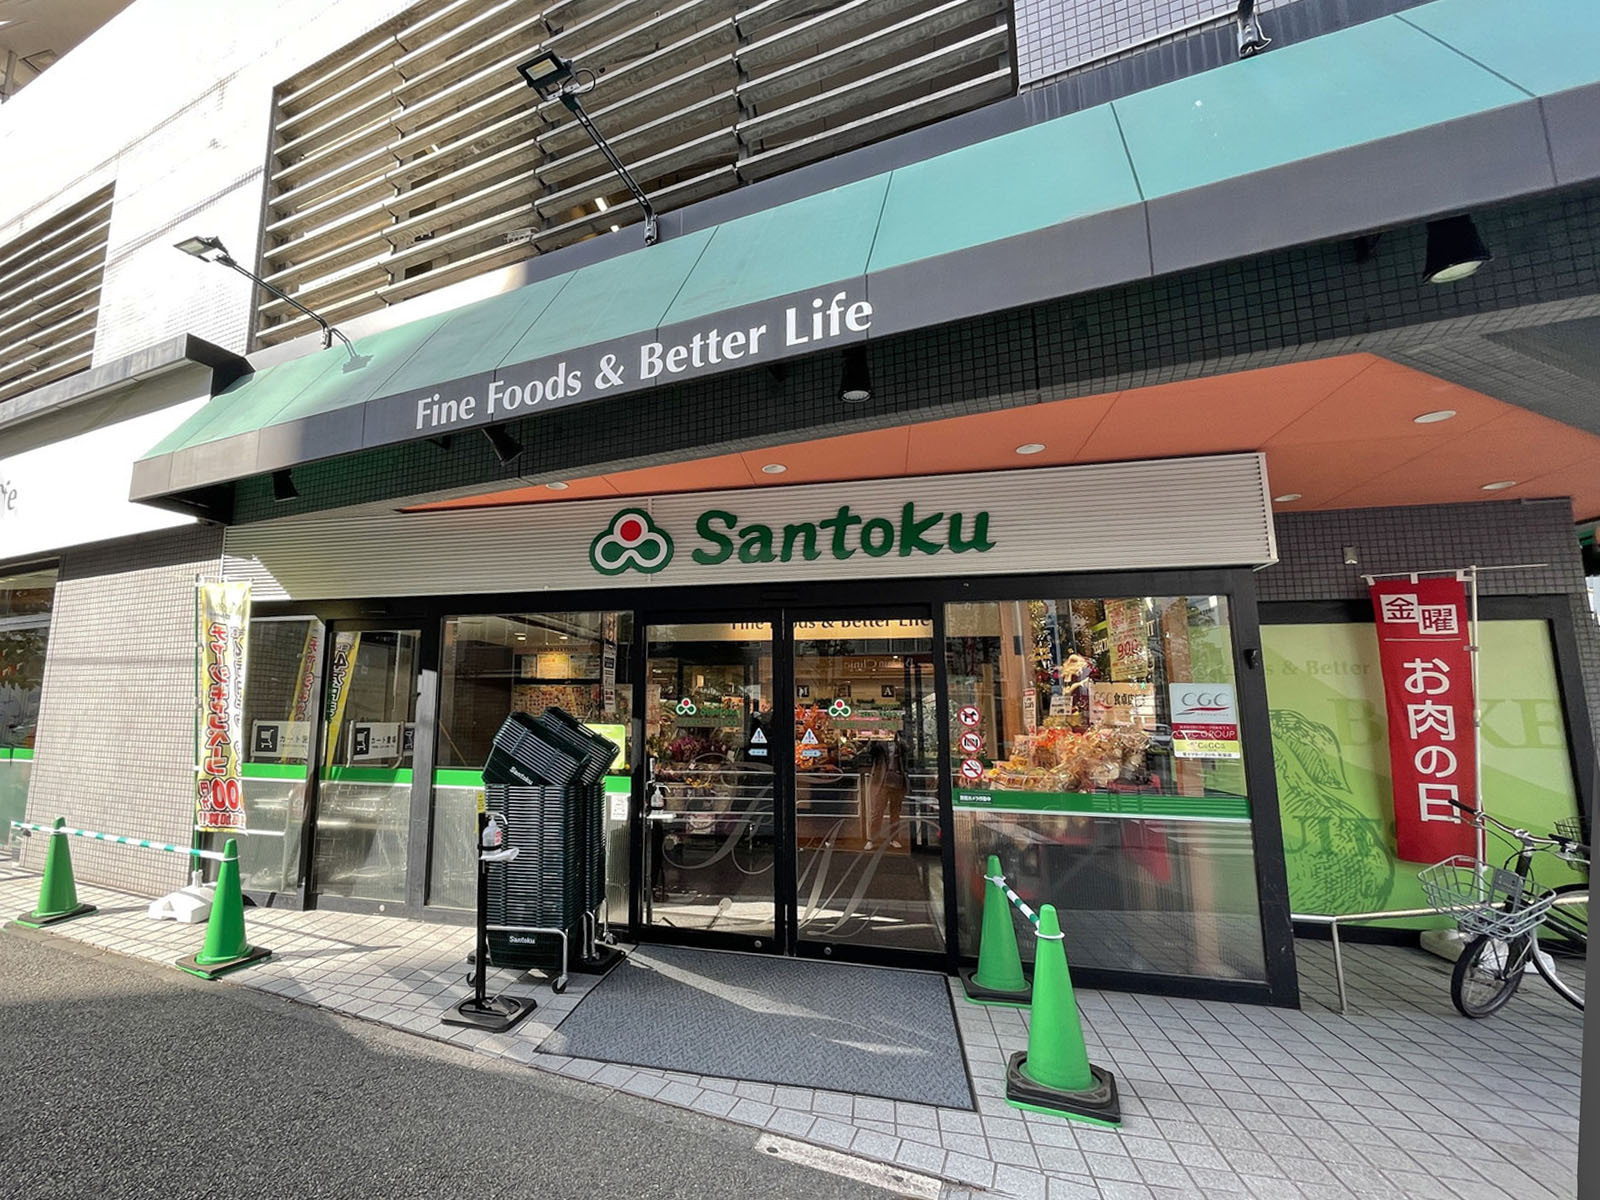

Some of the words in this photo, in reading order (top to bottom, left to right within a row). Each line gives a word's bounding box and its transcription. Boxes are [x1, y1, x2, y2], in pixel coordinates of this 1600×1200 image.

[415, 393, 475, 430] Fine
[487, 362, 582, 414] Foods
[594, 353, 624, 389] &
[640, 322, 767, 380] Better
[785, 291, 874, 347] Life
[691, 501, 997, 566] Santoku
[1385, 597, 1455, 633] 金曜
[1305, 660, 1371, 676] Better
[1181, 691, 1230, 707] CGC
[1402, 657, 1462, 825] お肉の日
[508, 935, 536, 945] Santoku
